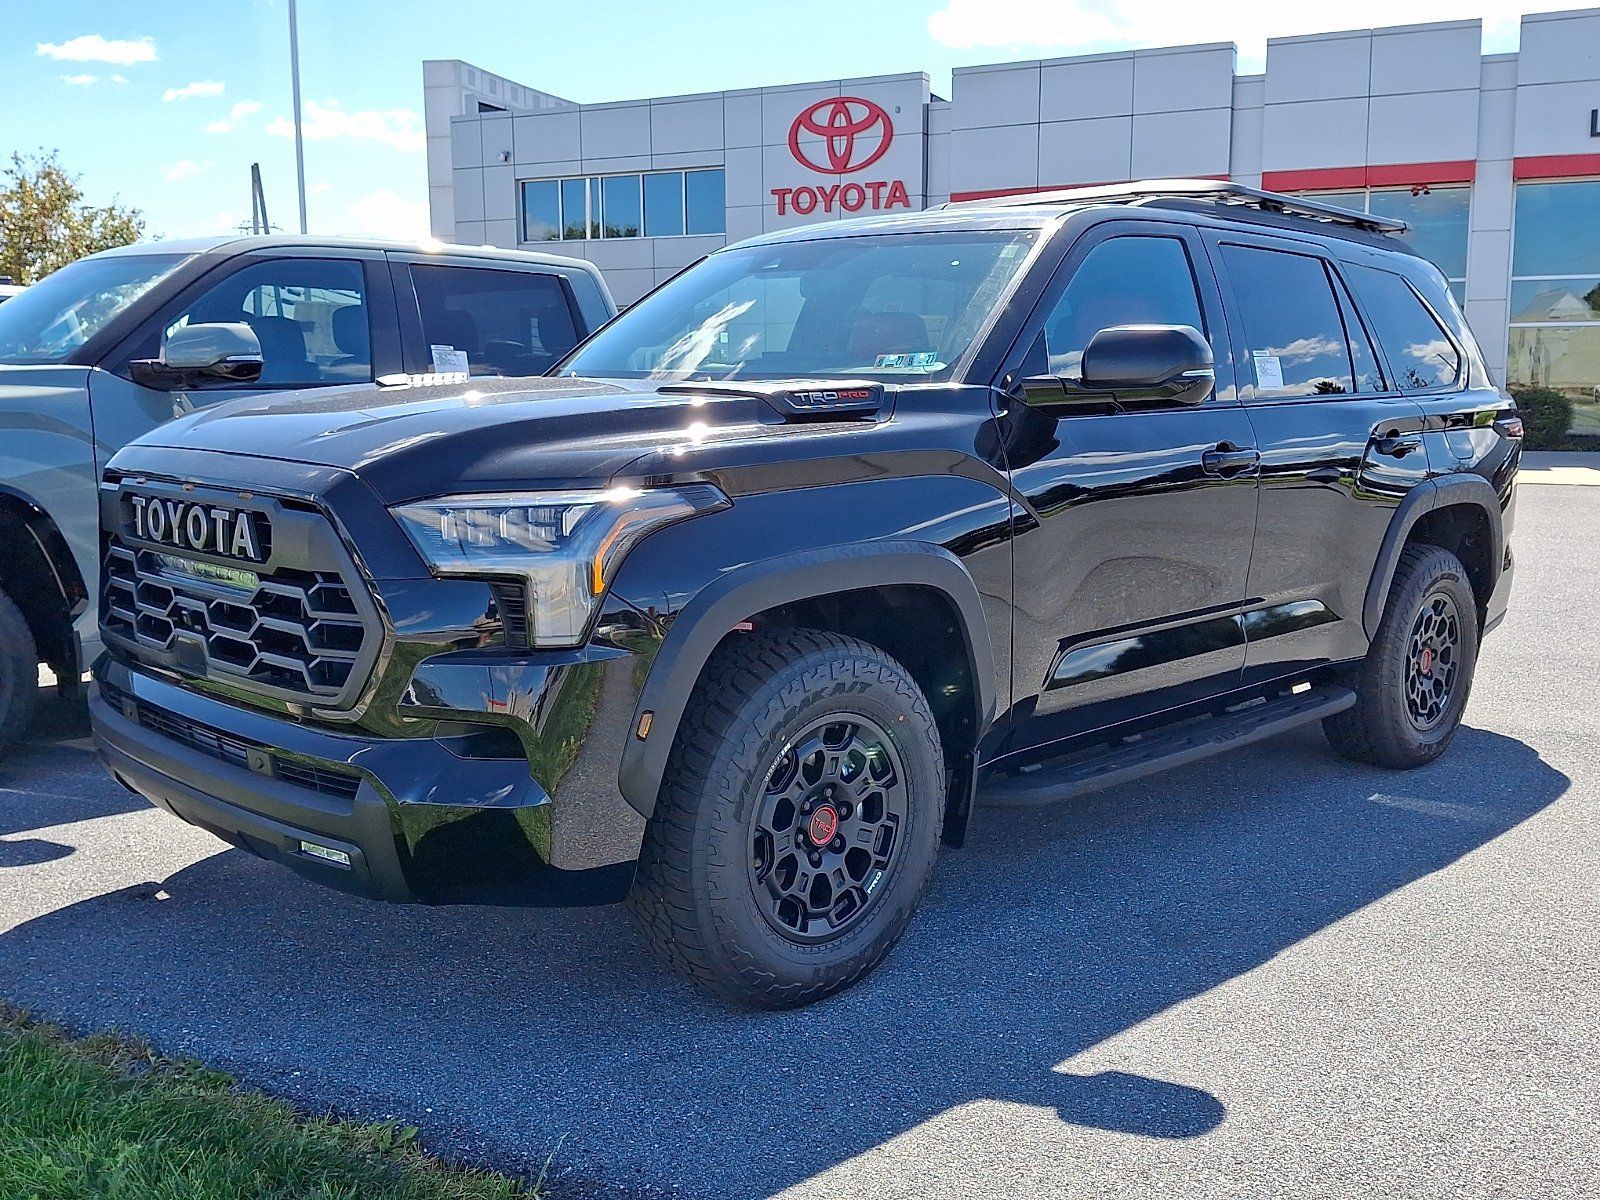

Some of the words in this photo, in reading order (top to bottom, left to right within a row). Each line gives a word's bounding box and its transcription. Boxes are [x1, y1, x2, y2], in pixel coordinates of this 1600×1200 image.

[770, 180, 911, 216] TOYOTA
[132, 496, 257, 559] TOYOTA
[814, 817, 832, 833] TRD
